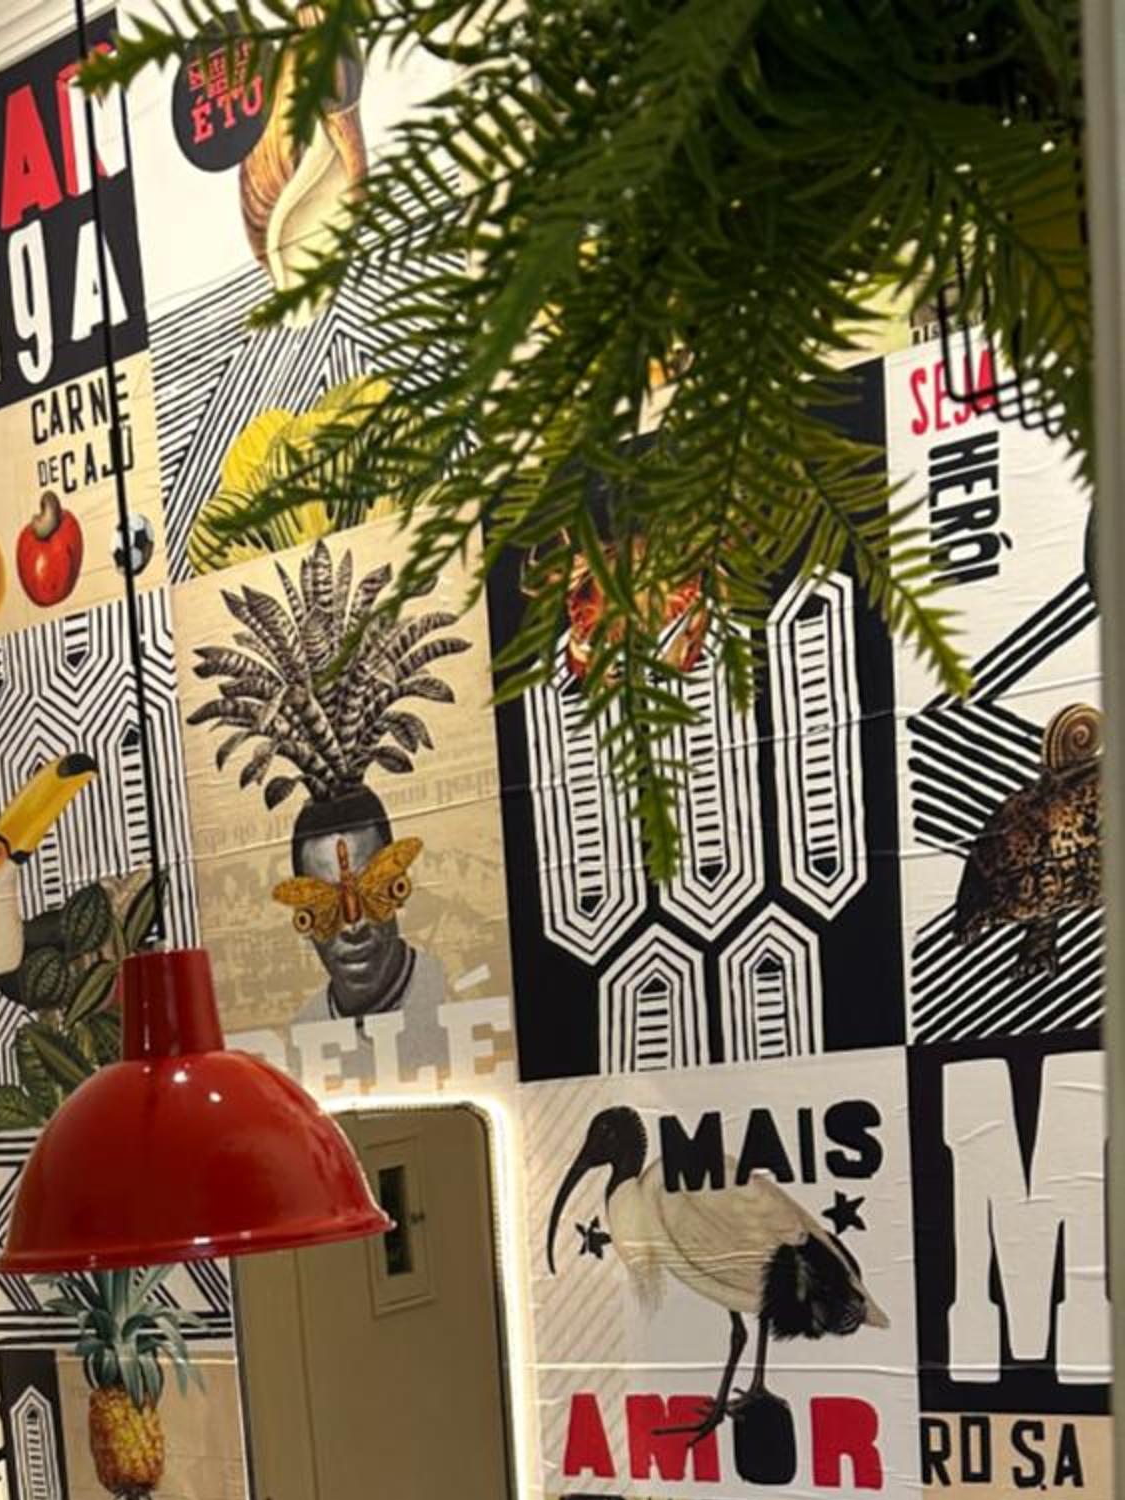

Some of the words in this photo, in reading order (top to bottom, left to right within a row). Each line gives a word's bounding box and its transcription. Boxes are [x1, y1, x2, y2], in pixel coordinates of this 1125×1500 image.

[30, 372, 130, 446] CARNE
[659, 1099, 884, 1193] MAIS
[562, 1393, 884, 1489] AMOR
[920, 1414, 1084, 1490] ROSA
